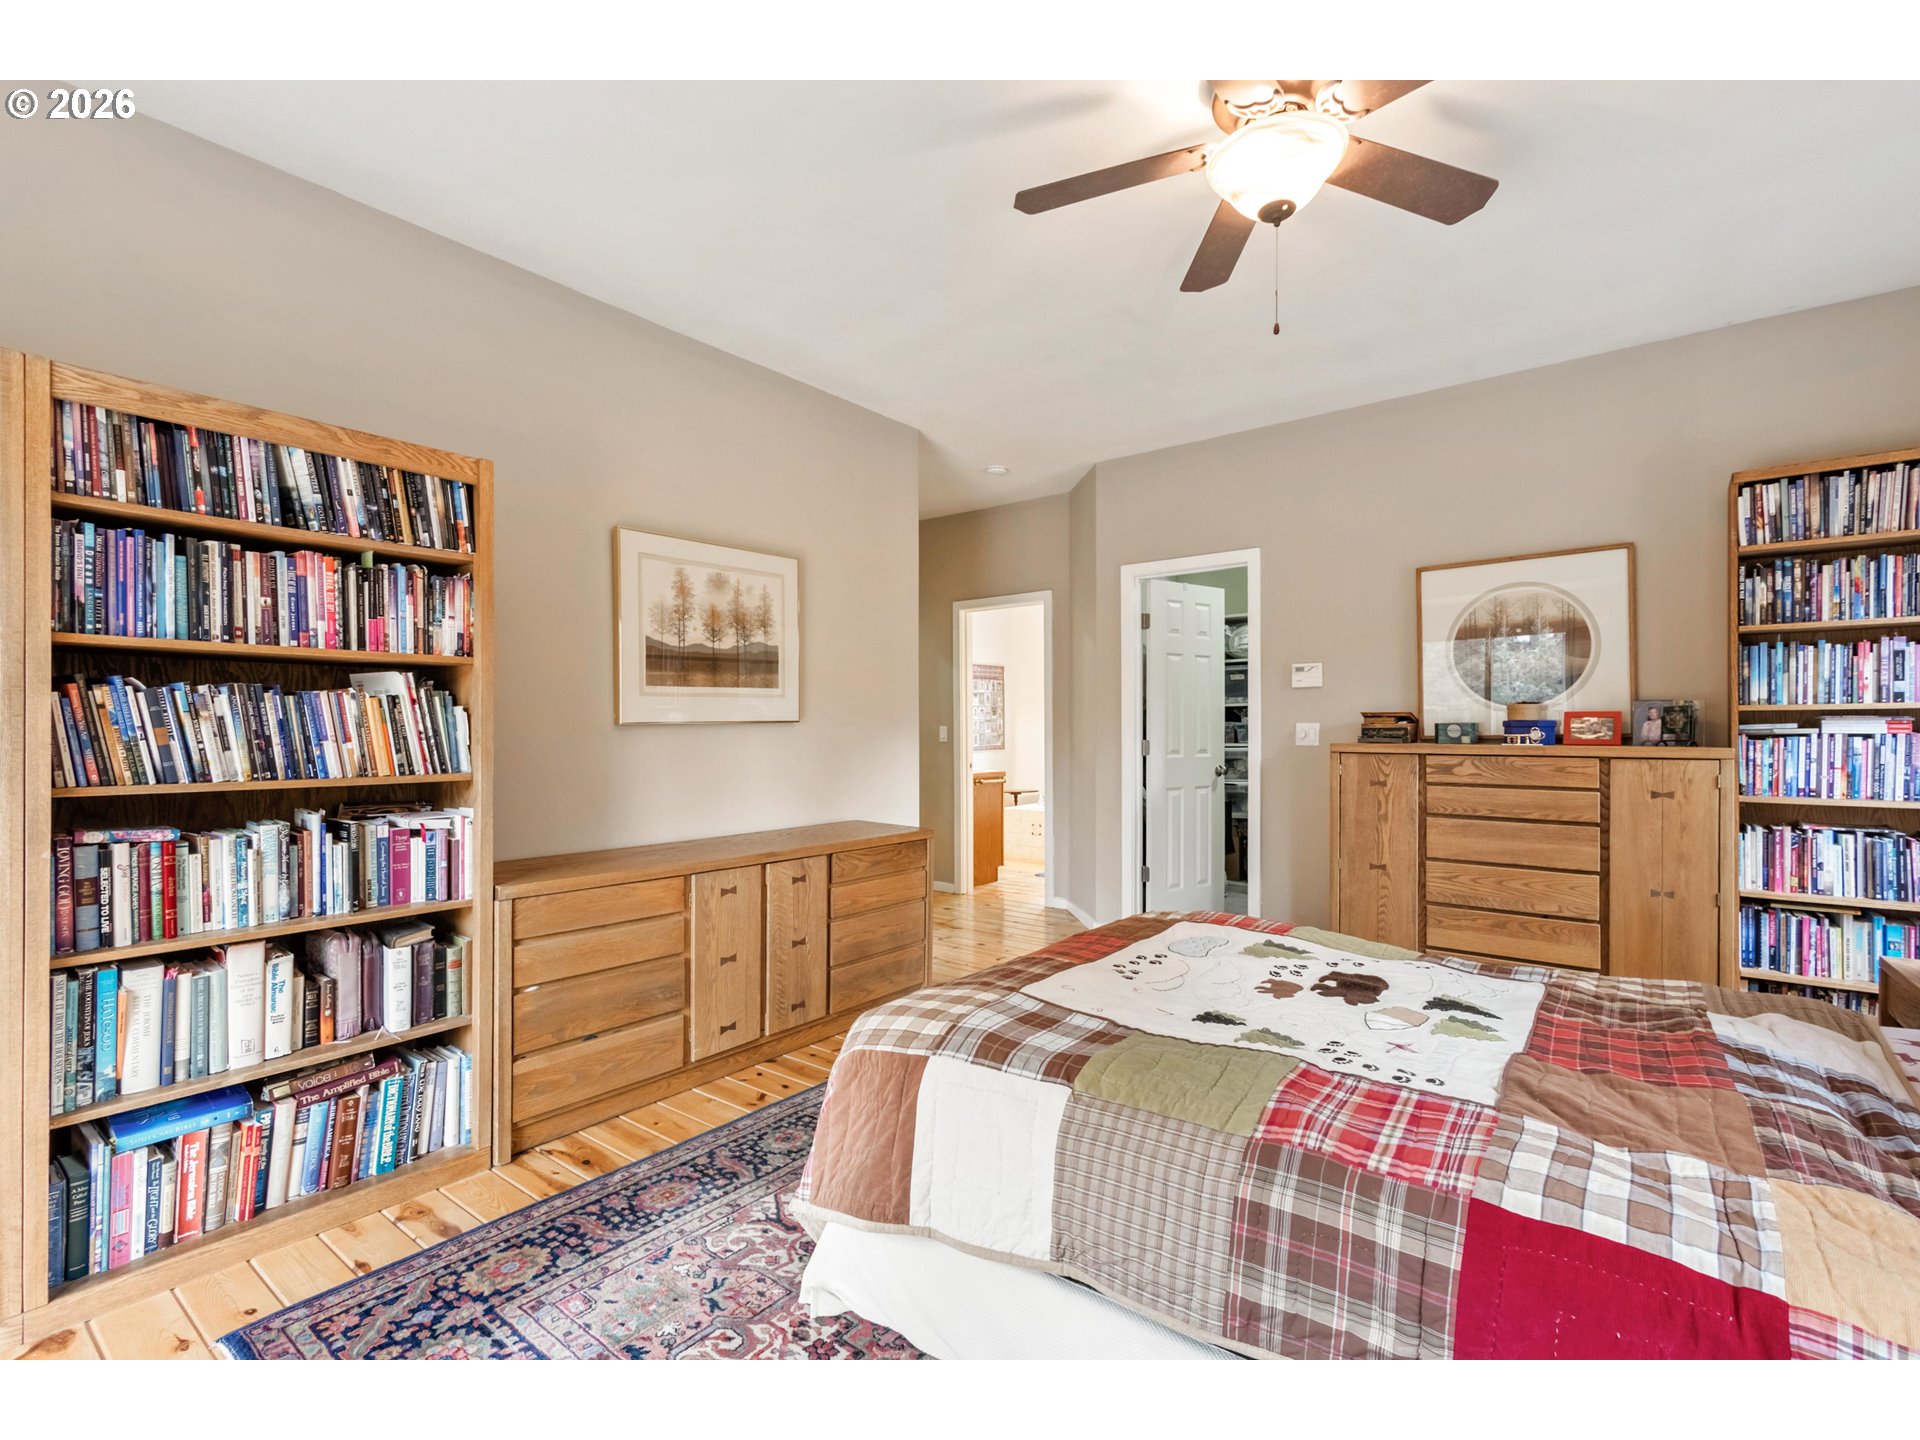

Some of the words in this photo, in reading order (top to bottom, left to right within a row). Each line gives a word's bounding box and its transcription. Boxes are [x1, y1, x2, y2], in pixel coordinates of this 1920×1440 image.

[317, 505, 326, 524] GOLL
[116, 679, 126, 701] DUTCH
[123, 702, 133, 726] SHEETS
[184, 685, 193, 703] PRAYING
[191, 719, 203, 743] SORROWS
[86, 749, 96, 771] SHEETS
[134, 746, 144, 774] DREAM
[57, 847, 71, 883] LOVING
[100, 867, 109, 904] SELECTED
[57, 885, 71, 910] GOD
[100, 905, 109, 916] TO
[101, 917, 109, 934] LIVE
[271, 963, 280, 980] Bible
[56, 980, 64, 1003] SHOUT
[270, 982, 278, 1014] Almanac
[278, 980, 286, 993] The
[56, 1003, 64, 1011] IT
[325, 994, 333, 1008] Calling
[55, 1012, 64, 1031] FROM
[55, 1034, 64, 1047] THE
[83, 1031, 91, 1047] JESUS
[130, 1029, 139, 1079] COMMENTARY
[54, 1048, 64, 1085] HOUSETOPS
[300, 1093, 319, 1105] The
[323, 1075, 366, 1097] Amplified
[369, 1068, 390, 1079] Bible
[328, 1105, 336, 1124] BIBLE
[384, 1085, 399, 1125] DICTIONARY
[384, 1131, 394, 1142] the
[397, 1106, 411, 1144] DICTIONARY
[189, 1141, 200, 1158] The
[325, 1128, 334, 1158] AMERICA
[381, 1142, 393, 1165] BIBLE
[187, 1160, 199, 1199] Jerusalem
[148, 1186, 160, 1208] LIGHT
[186, 1199, 197, 1220] Bible
[147, 1218, 158, 1244] GLORY
